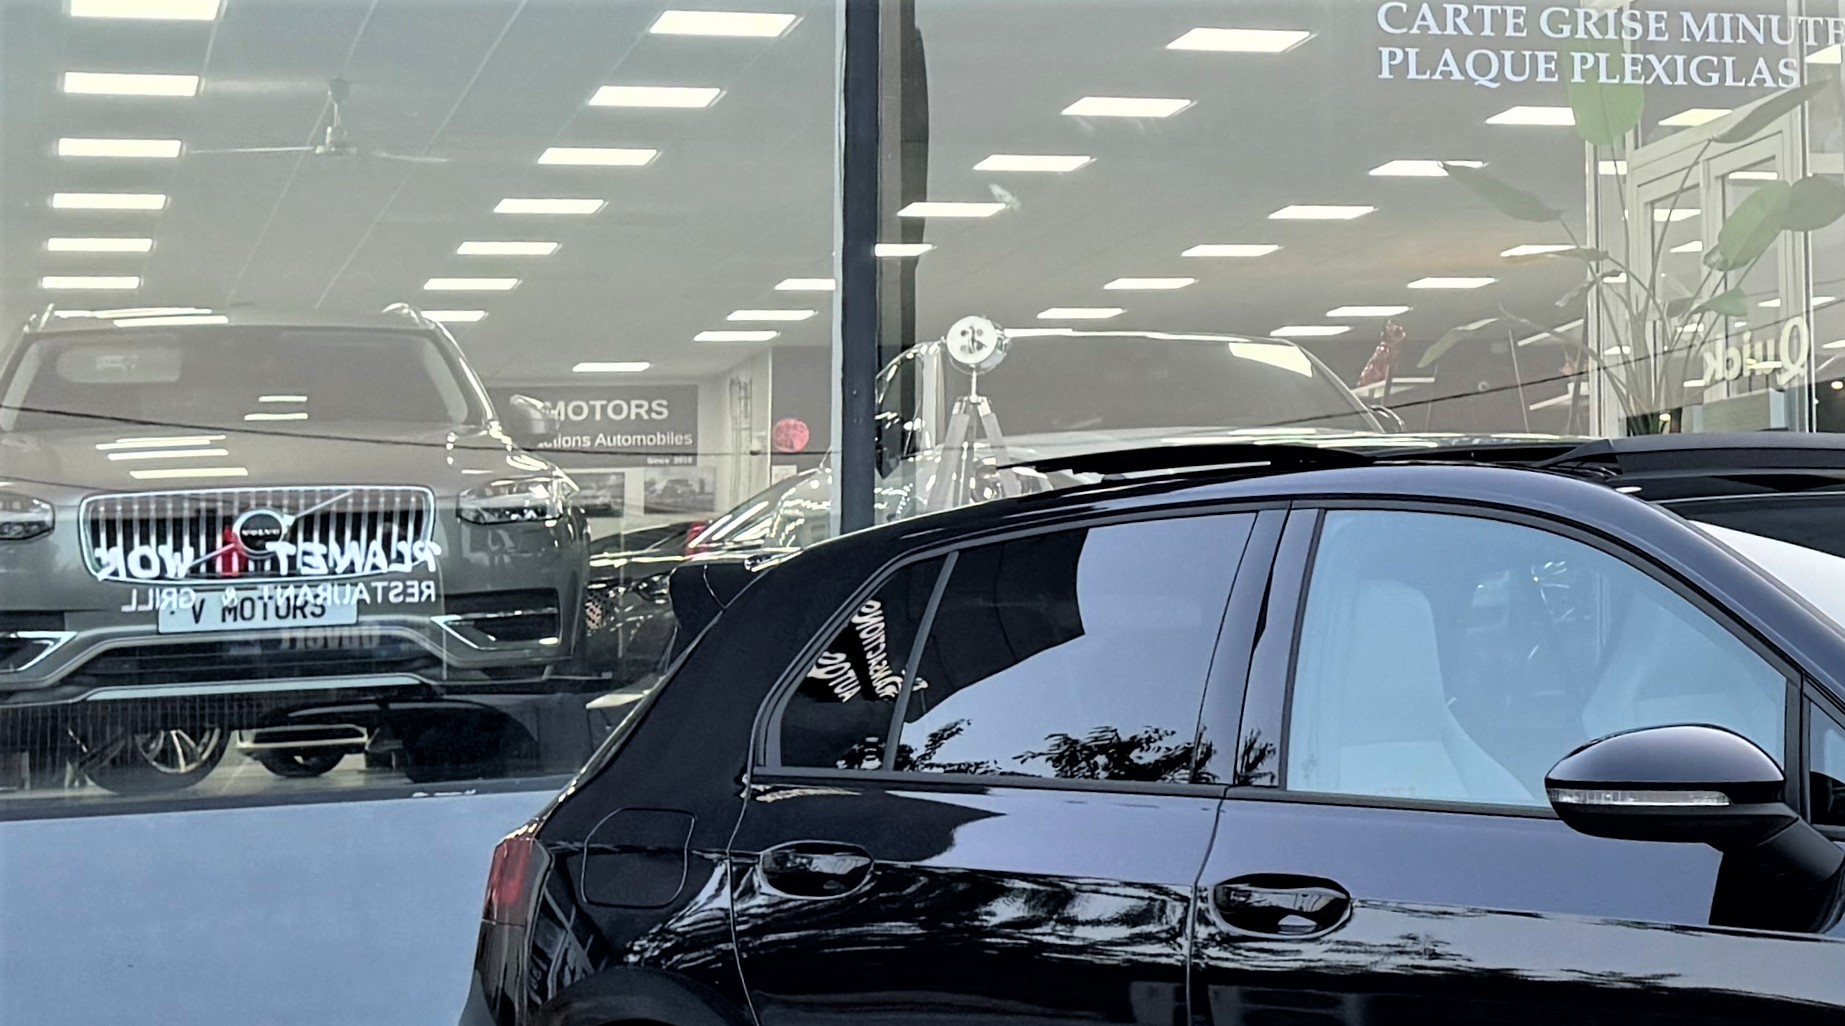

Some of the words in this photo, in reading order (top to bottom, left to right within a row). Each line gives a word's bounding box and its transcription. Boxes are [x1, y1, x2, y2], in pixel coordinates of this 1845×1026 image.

[1377, 2, 1527, 38] CARTE
[1540, 7, 1669, 41] GRISE
[1378, 47, 1558, 88] PLAQUE
[1571, 54, 1800, 88] PLEXIGLAS
[594, 431, 693, 448] Automobiles
